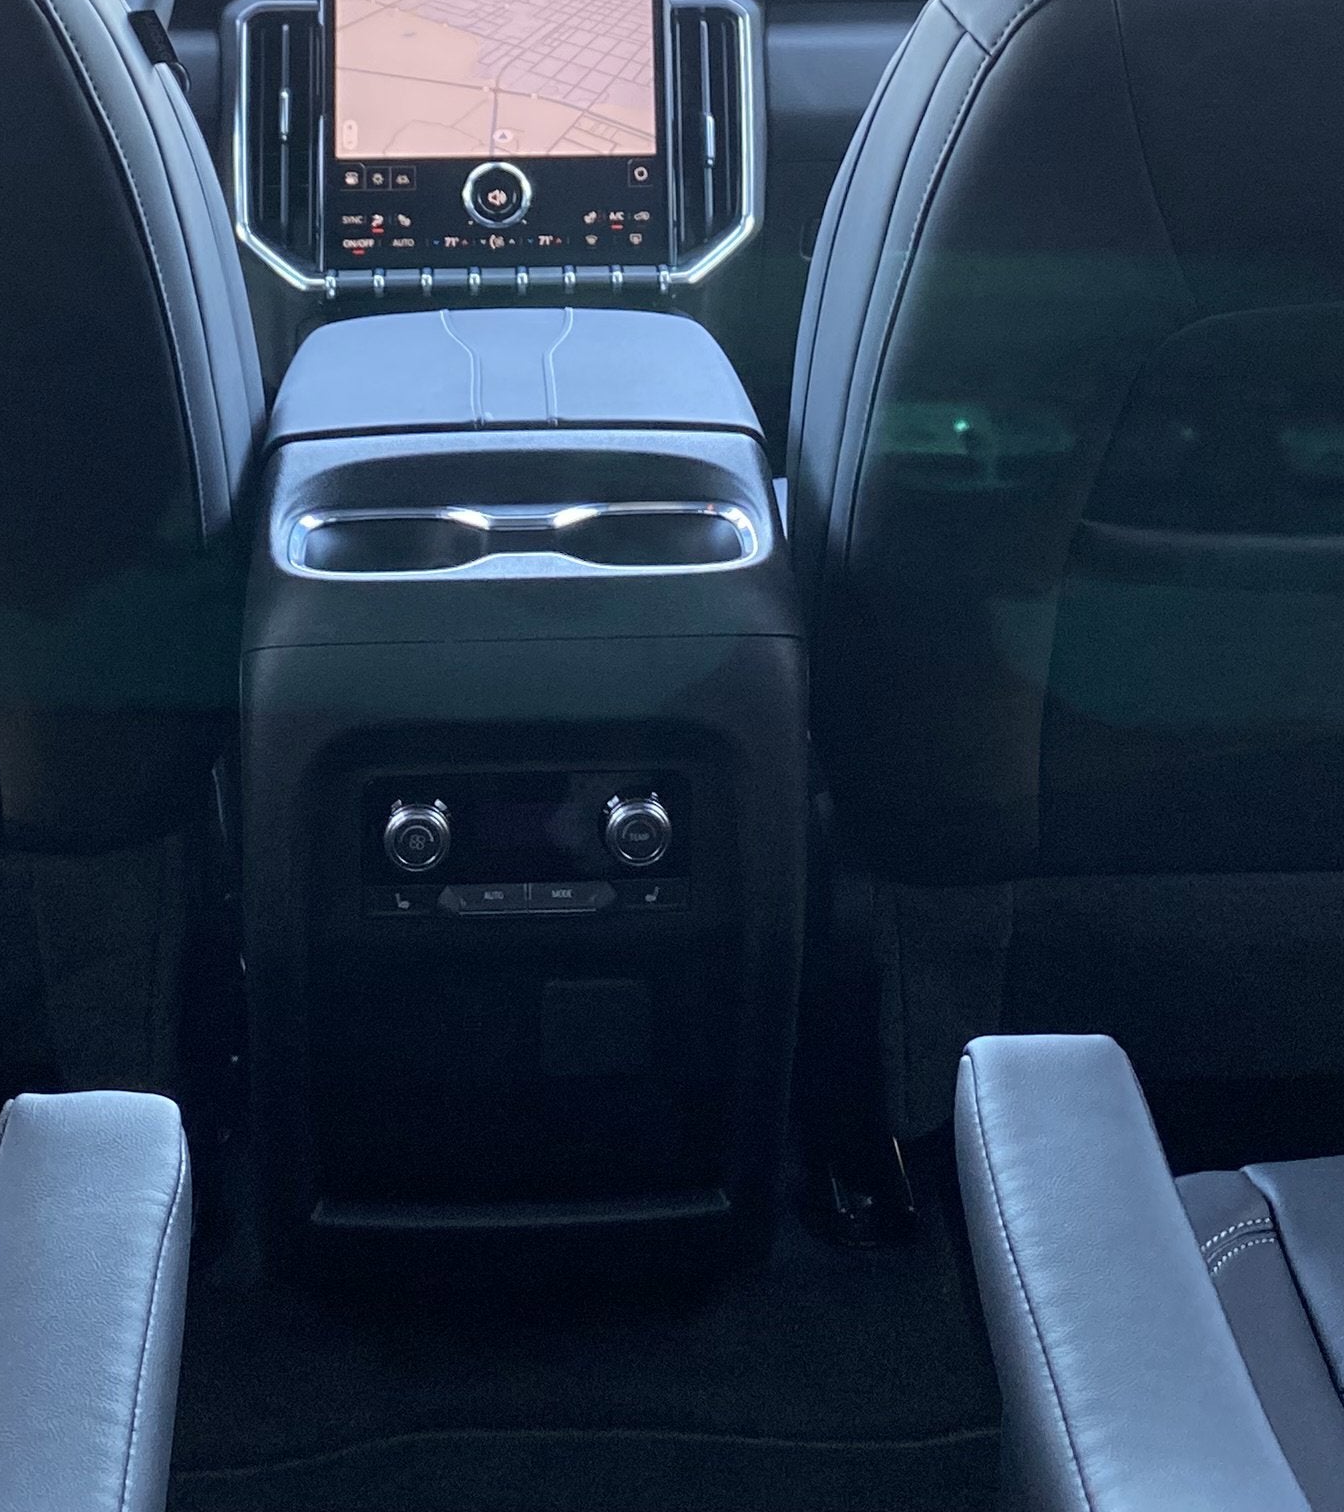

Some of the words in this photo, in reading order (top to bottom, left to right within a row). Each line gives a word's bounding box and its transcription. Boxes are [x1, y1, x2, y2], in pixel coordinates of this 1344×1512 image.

[342, 215, 364, 225] SYNC
[342, 238, 375, 248] ON/OFF
[392, 238, 415, 247] AUTO
[484, 890, 505, 900] AUTO
[551, 889, 573, 898] MODE
